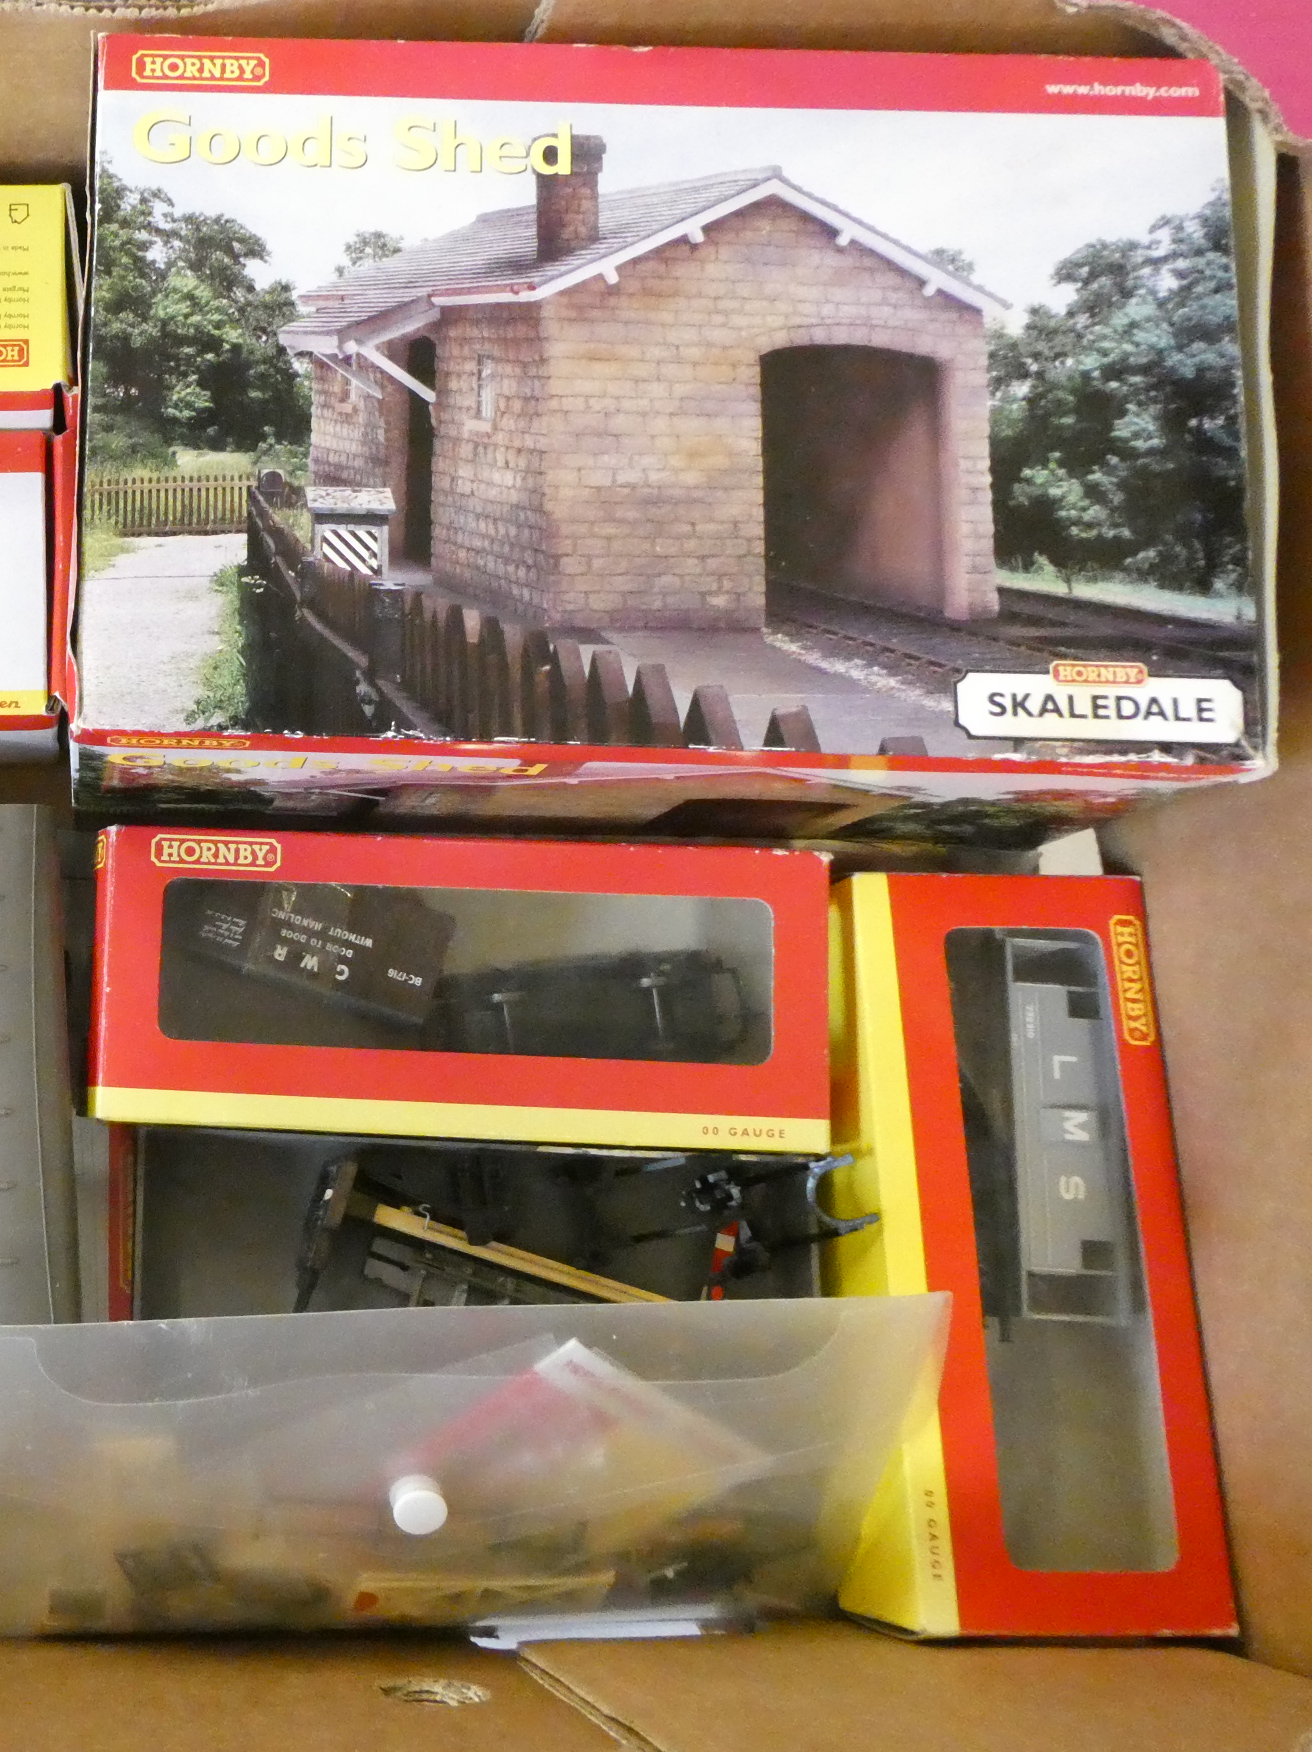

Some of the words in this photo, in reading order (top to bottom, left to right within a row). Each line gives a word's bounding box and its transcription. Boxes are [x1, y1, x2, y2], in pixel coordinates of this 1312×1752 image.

[143, 57, 256, 79] HORNBY
[1046, 82, 1199, 100] www.hornby.com
[132, 109, 368, 169] Goods
[394, 115, 574, 176] Shed
[1059, 665, 1138, 685] HORNBY
[988, 692, 1216, 723] SKALEDALE
[118, 737, 238, 748] HORNBY
[107, 751, 340, 771] Goods
[370, 757, 548, 776] Shed
[161, 840, 271, 866] HORNBY
[279, 927, 308, 943] DOOR
[309, 936, 324, 948] TO
[328, 927, 374, 948] WITHOUT
[325, 943, 354, 958] DOOR
[1114, 925, 1150, 1036] HORNBY
[729, 1126, 786, 1140] GAUGE
